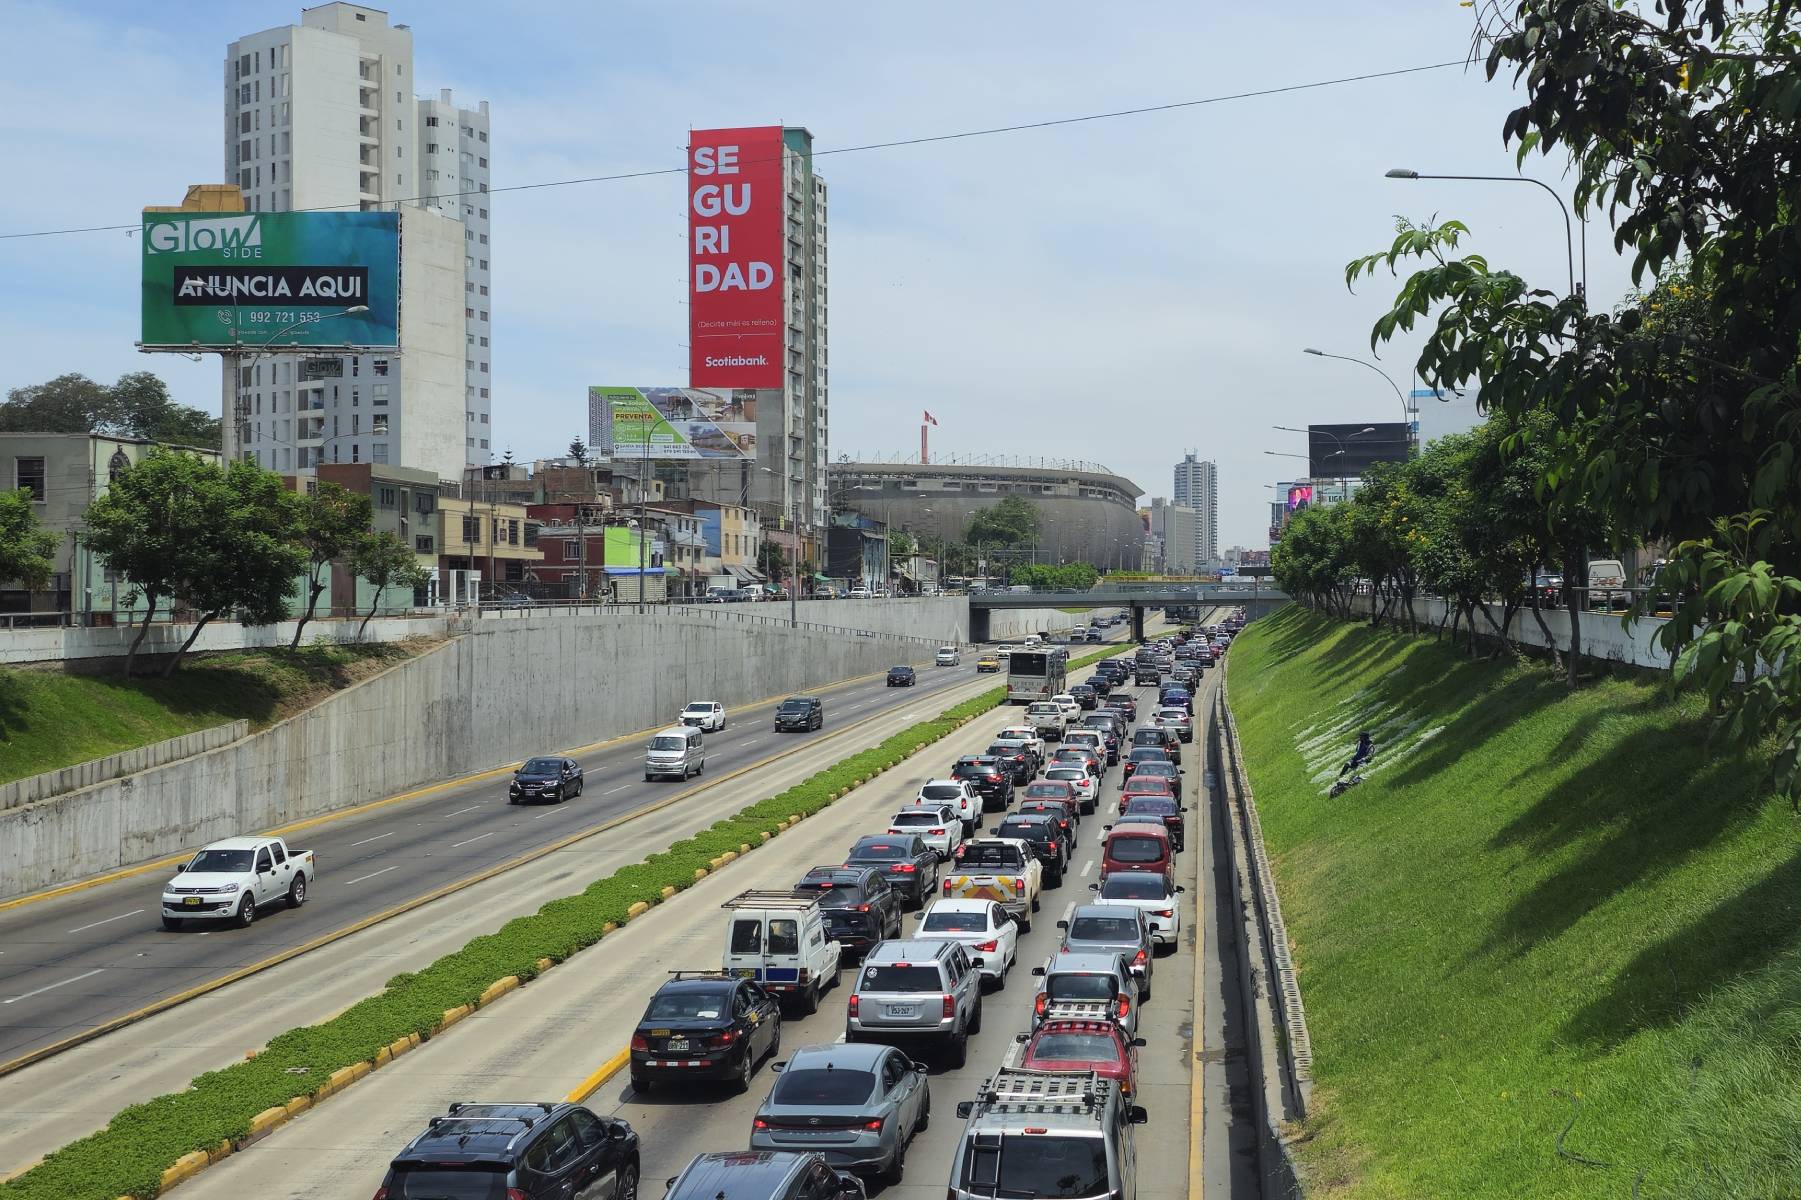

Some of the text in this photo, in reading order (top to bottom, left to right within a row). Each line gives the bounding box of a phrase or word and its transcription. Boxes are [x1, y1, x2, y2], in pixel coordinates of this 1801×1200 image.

[693, 145, 740, 176] SE
[692, 183, 752, 218] GU
[223, 247, 262, 258] SIDE
[695, 225, 730, 255] RI
[178, 275, 361, 298] ANUNCIA AQUI
[695, 261, 774, 293] DAD
[249, 311, 321, 323] 992 721 553
